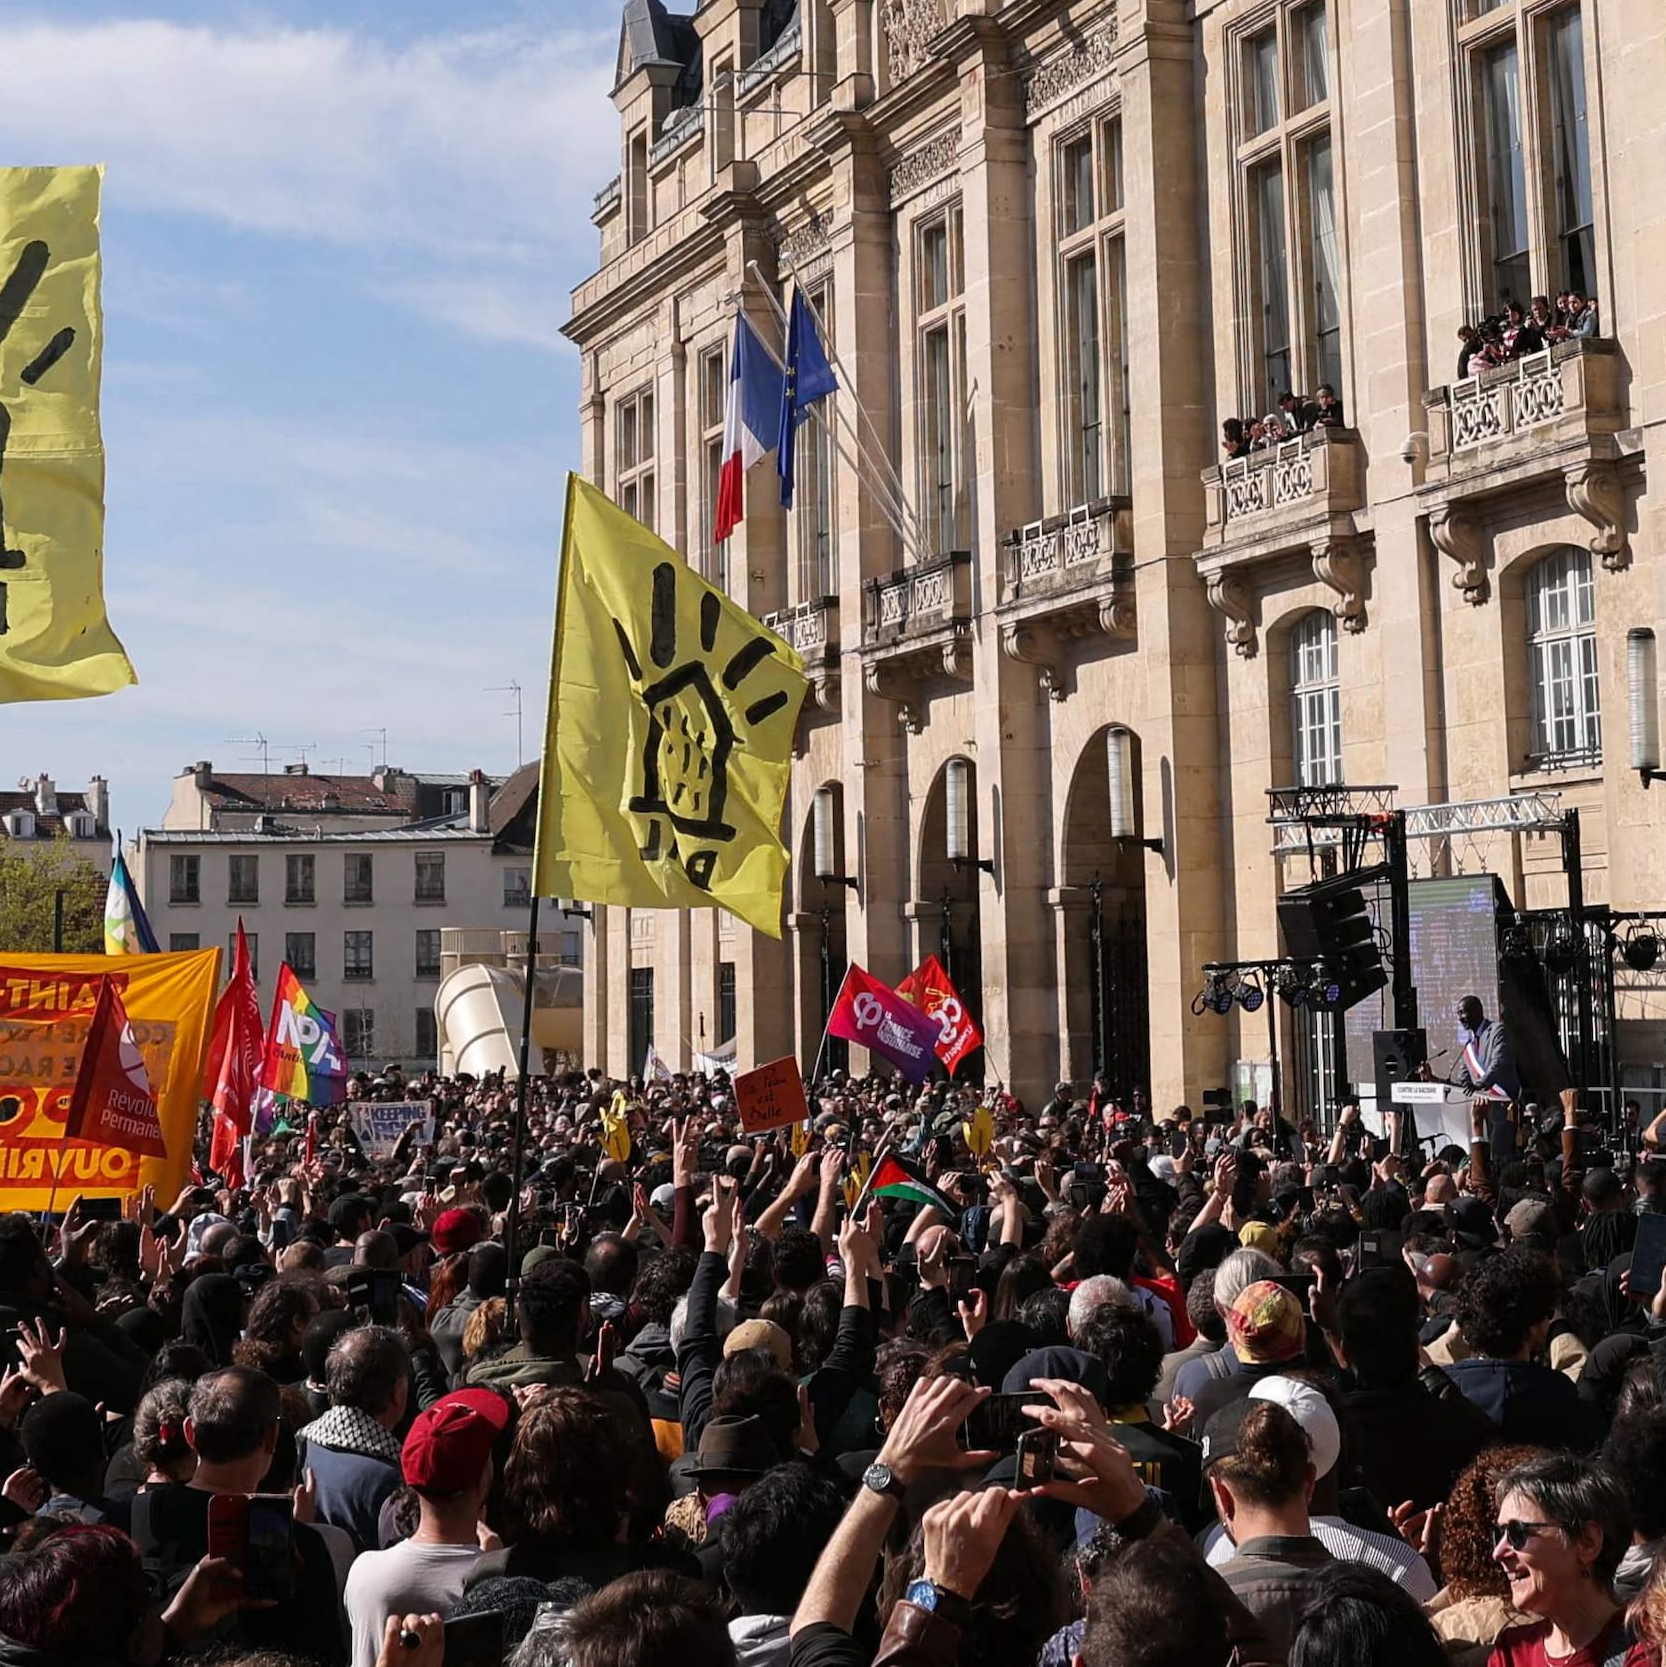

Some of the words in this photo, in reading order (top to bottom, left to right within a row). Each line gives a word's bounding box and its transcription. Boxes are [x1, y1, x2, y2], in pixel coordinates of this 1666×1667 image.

[107, 1089, 158, 1118] Révolu
[371, 1106, 426, 1121] KEEPING
[100, 1109, 161, 1140] Permane
